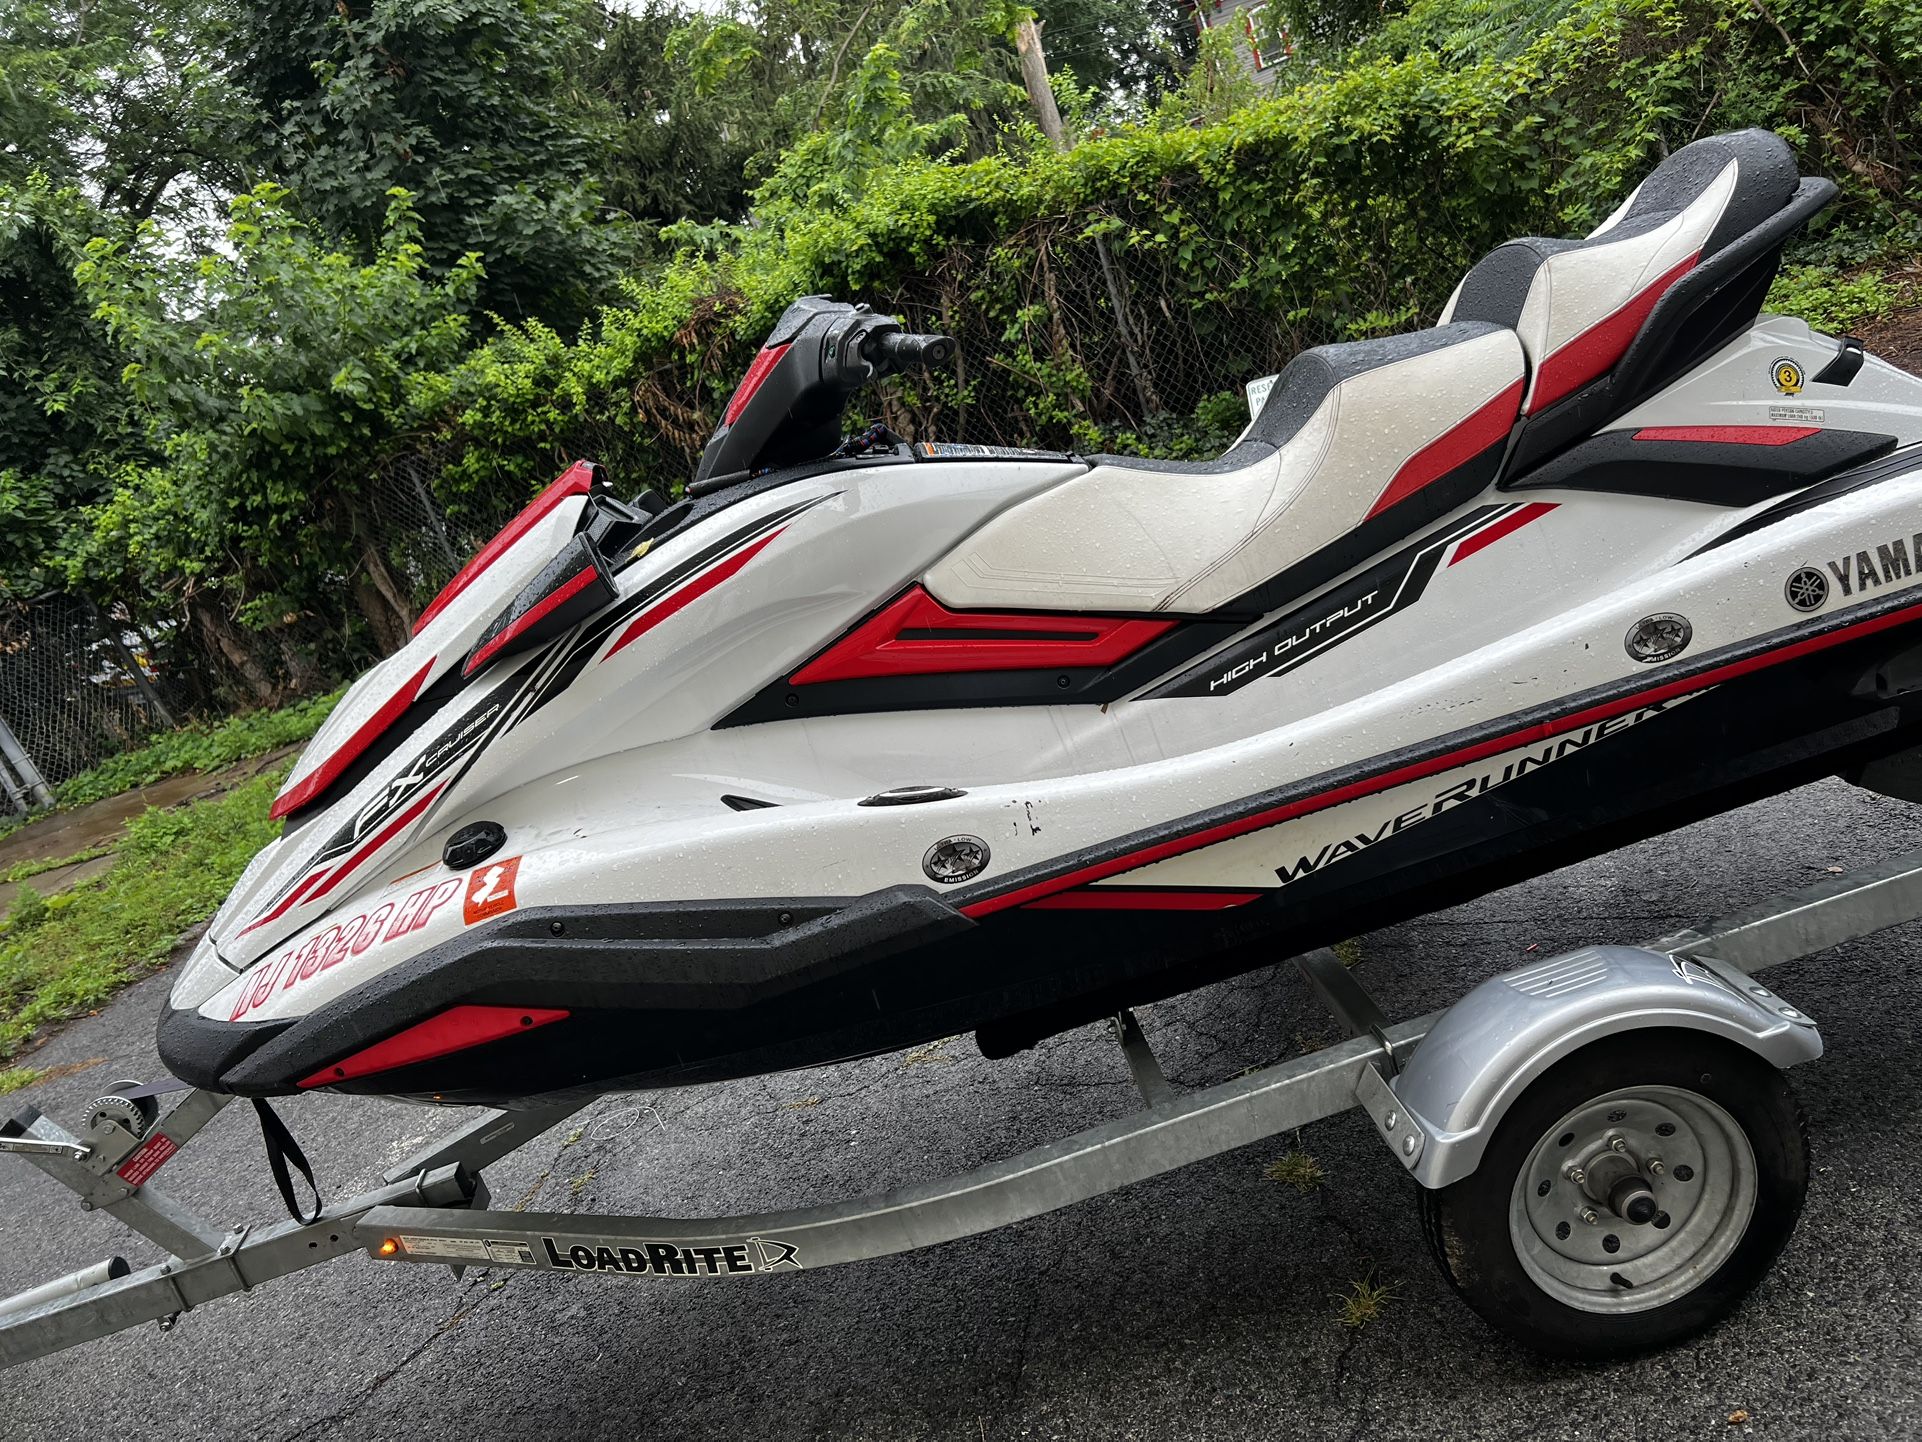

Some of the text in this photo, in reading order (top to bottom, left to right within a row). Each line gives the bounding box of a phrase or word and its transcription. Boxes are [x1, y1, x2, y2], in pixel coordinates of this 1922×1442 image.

[1783, 369, 1793, 383] 3
[1210, 590, 1378, 690] HIGH OUTPUT
[354, 703, 500, 840] FX CRUISER
[1273, 702, 1668, 885] WAVERUNNER
[944, 869, 979, 882] EMISSION
[229, 877, 463, 1022] NJ 1326 HP
